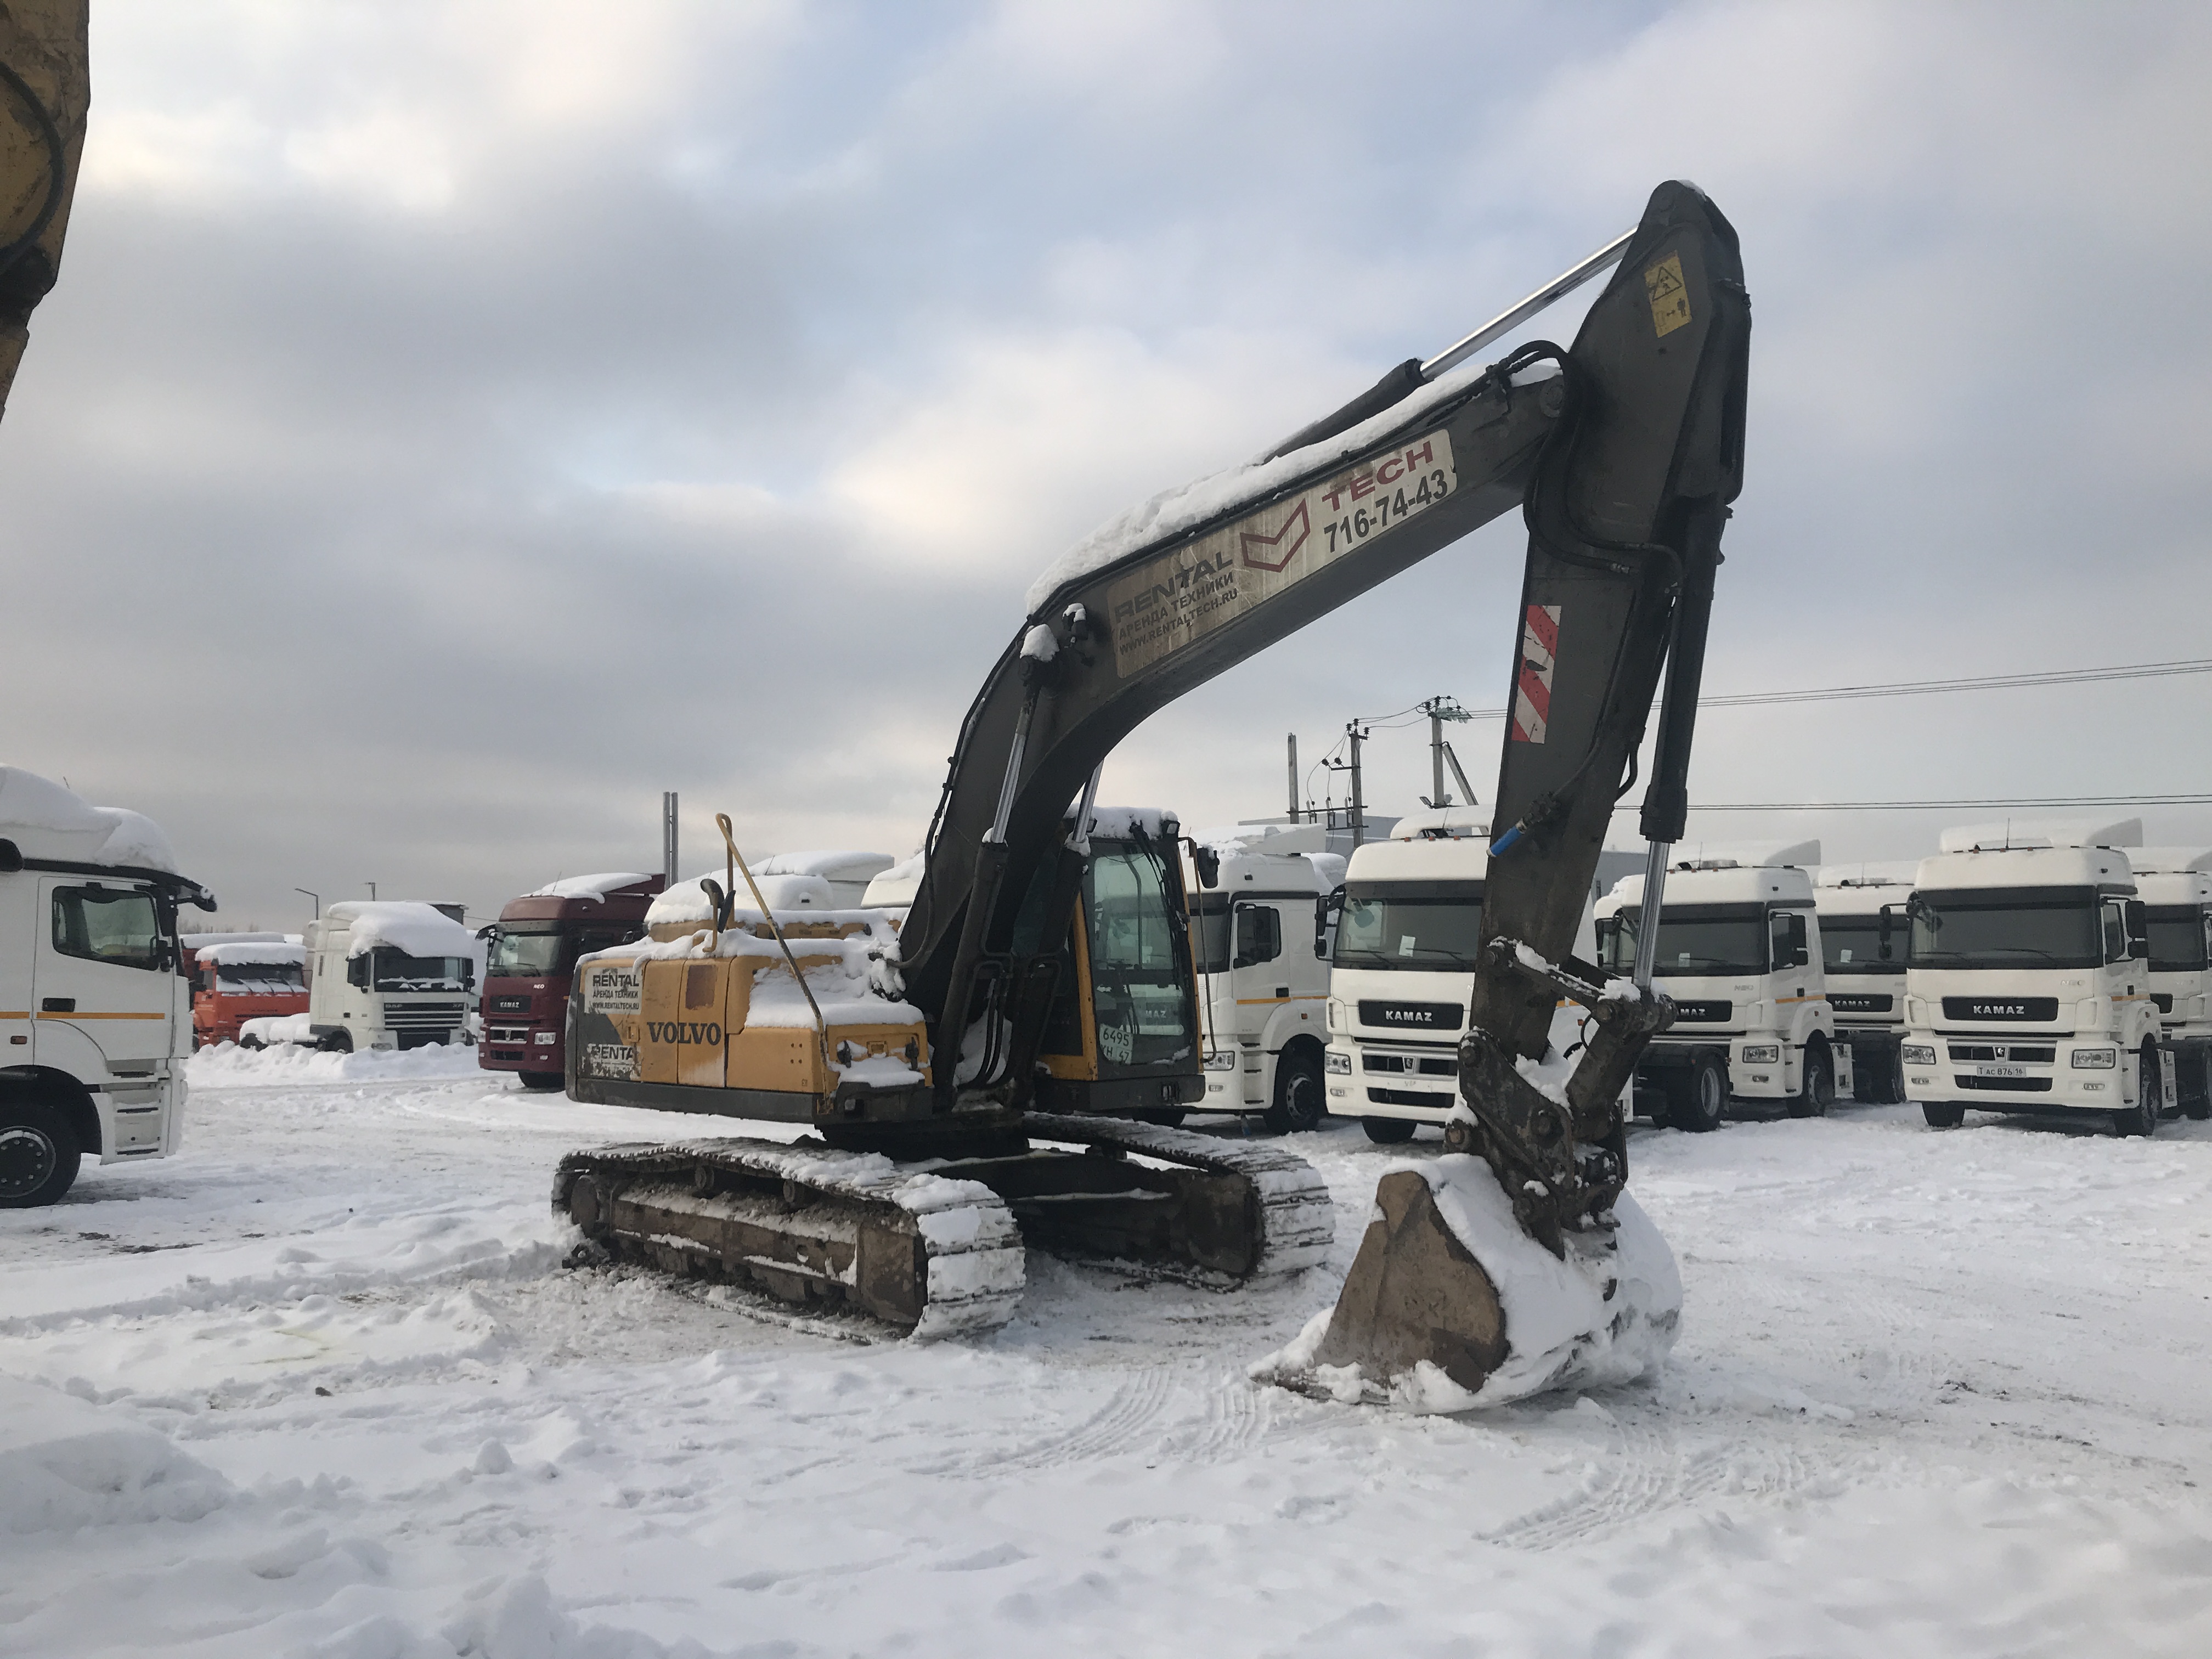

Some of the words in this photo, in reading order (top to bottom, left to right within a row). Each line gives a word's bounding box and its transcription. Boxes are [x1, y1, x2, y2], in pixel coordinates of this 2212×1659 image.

[1322, 441, 1434, 511] TECH
[1324, 469, 1448, 553] 716-74-43
[1114, 551, 1233, 623] RENTAL
[1119, 607, 1168, 640] АРЕНДА
[1171, 572, 1233, 612] ТЕХНИКИ
[1120, 588, 1238, 655] WWW.RENTALTECH.RU
[592, 973, 639, 986] RENTAL
[592, 990, 613, 999] АРЕНДА
[615, 990, 639, 998] ТЕХНИКИ
[1386, 1011, 1432, 1022] KAMAZ
[1973, 1005, 2024, 1014] KAMAZ
[647, 1022, 721, 1046] VOLVO
[1103, 1028, 1130, 1047] 6495
[589, 1046, 634, 1060] RENTA
